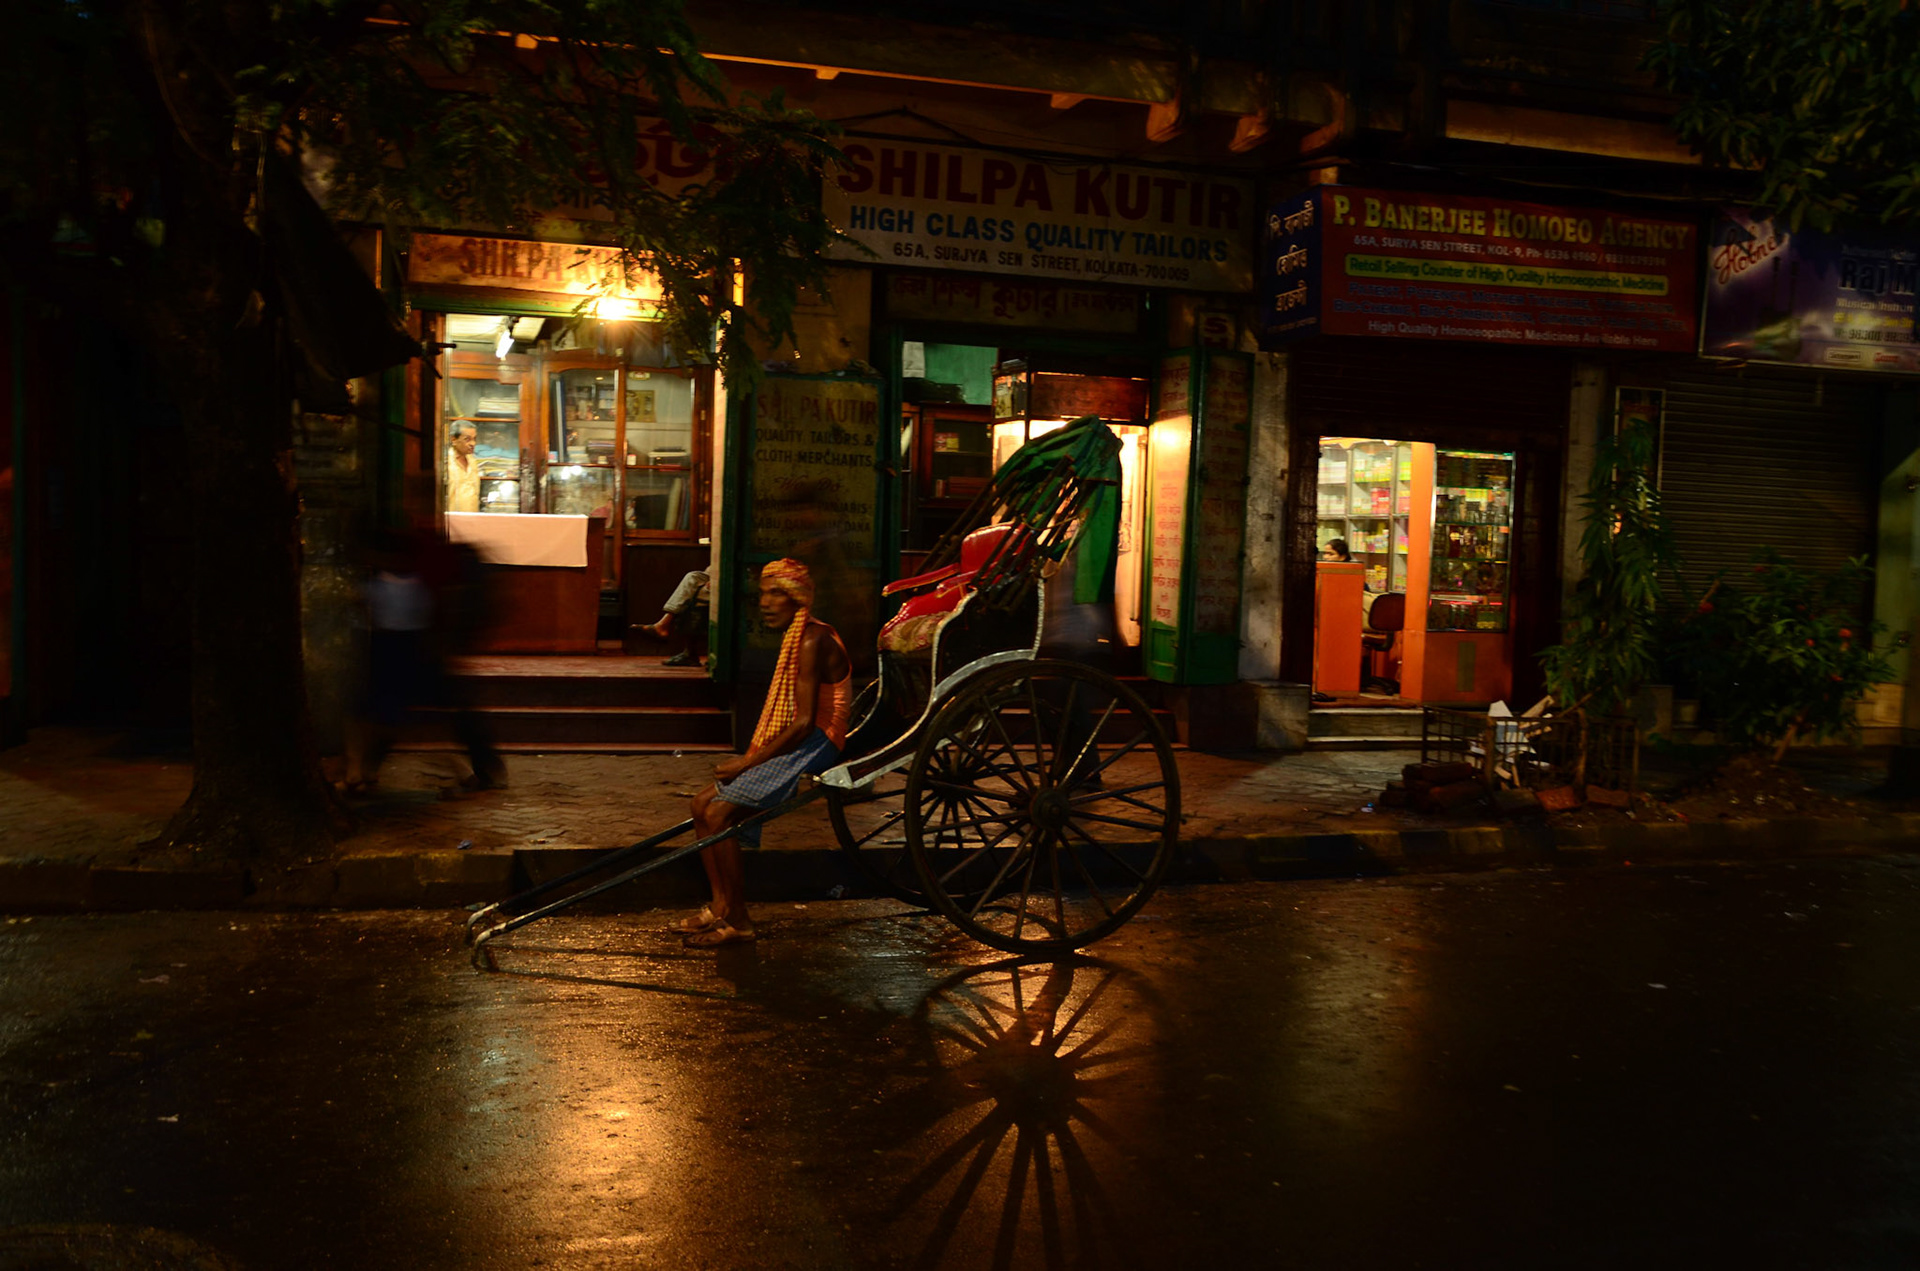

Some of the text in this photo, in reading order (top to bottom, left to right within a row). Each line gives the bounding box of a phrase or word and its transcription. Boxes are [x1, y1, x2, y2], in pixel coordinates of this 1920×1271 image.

[838, 144, 1052, 211] SHILPA
[1075, 169, 1240, 229] KUTIR
[851, 205, 1228, 261] HIGH CLASS QUALITY TAILORS
[1333, 194, 1689, 250] P. BANERJEE HOMOEO AGENCY
[894, 242, 929, 260] 65A,
[934, 245, 988, 264] SURJYA
[998, 251, 1023, 267] SEN
[1031, 254, 1082, 274] STREET,
[1381, 236, 1419, 250] SURYA
[1420, 239, 1442, 252] SEN
[1350, 257, 1382, 272] Retail
[1385, 260, 1419, 277] Selling
[1422, 262, 1464, 278] Counter
[1467, 266, 1478, 278] of
[1479, 267, 1504, 282] High
[1506, 268, 1544, 286] Quality
[1622, 277, 1666, 291] Medicine
[1838, 257, 1888, 296] Raj
[1368, 320, 1395, 334] High
[1398, 322, 1439, 337] Quality
[1525, 329, 1580, 344] Medicines
[1633, 335, 1659, 347] Here
[756, 428, 874, 447] QUALITY TAILORS &
[756, 449, 873, 468] CLOTH MERCHANTS
